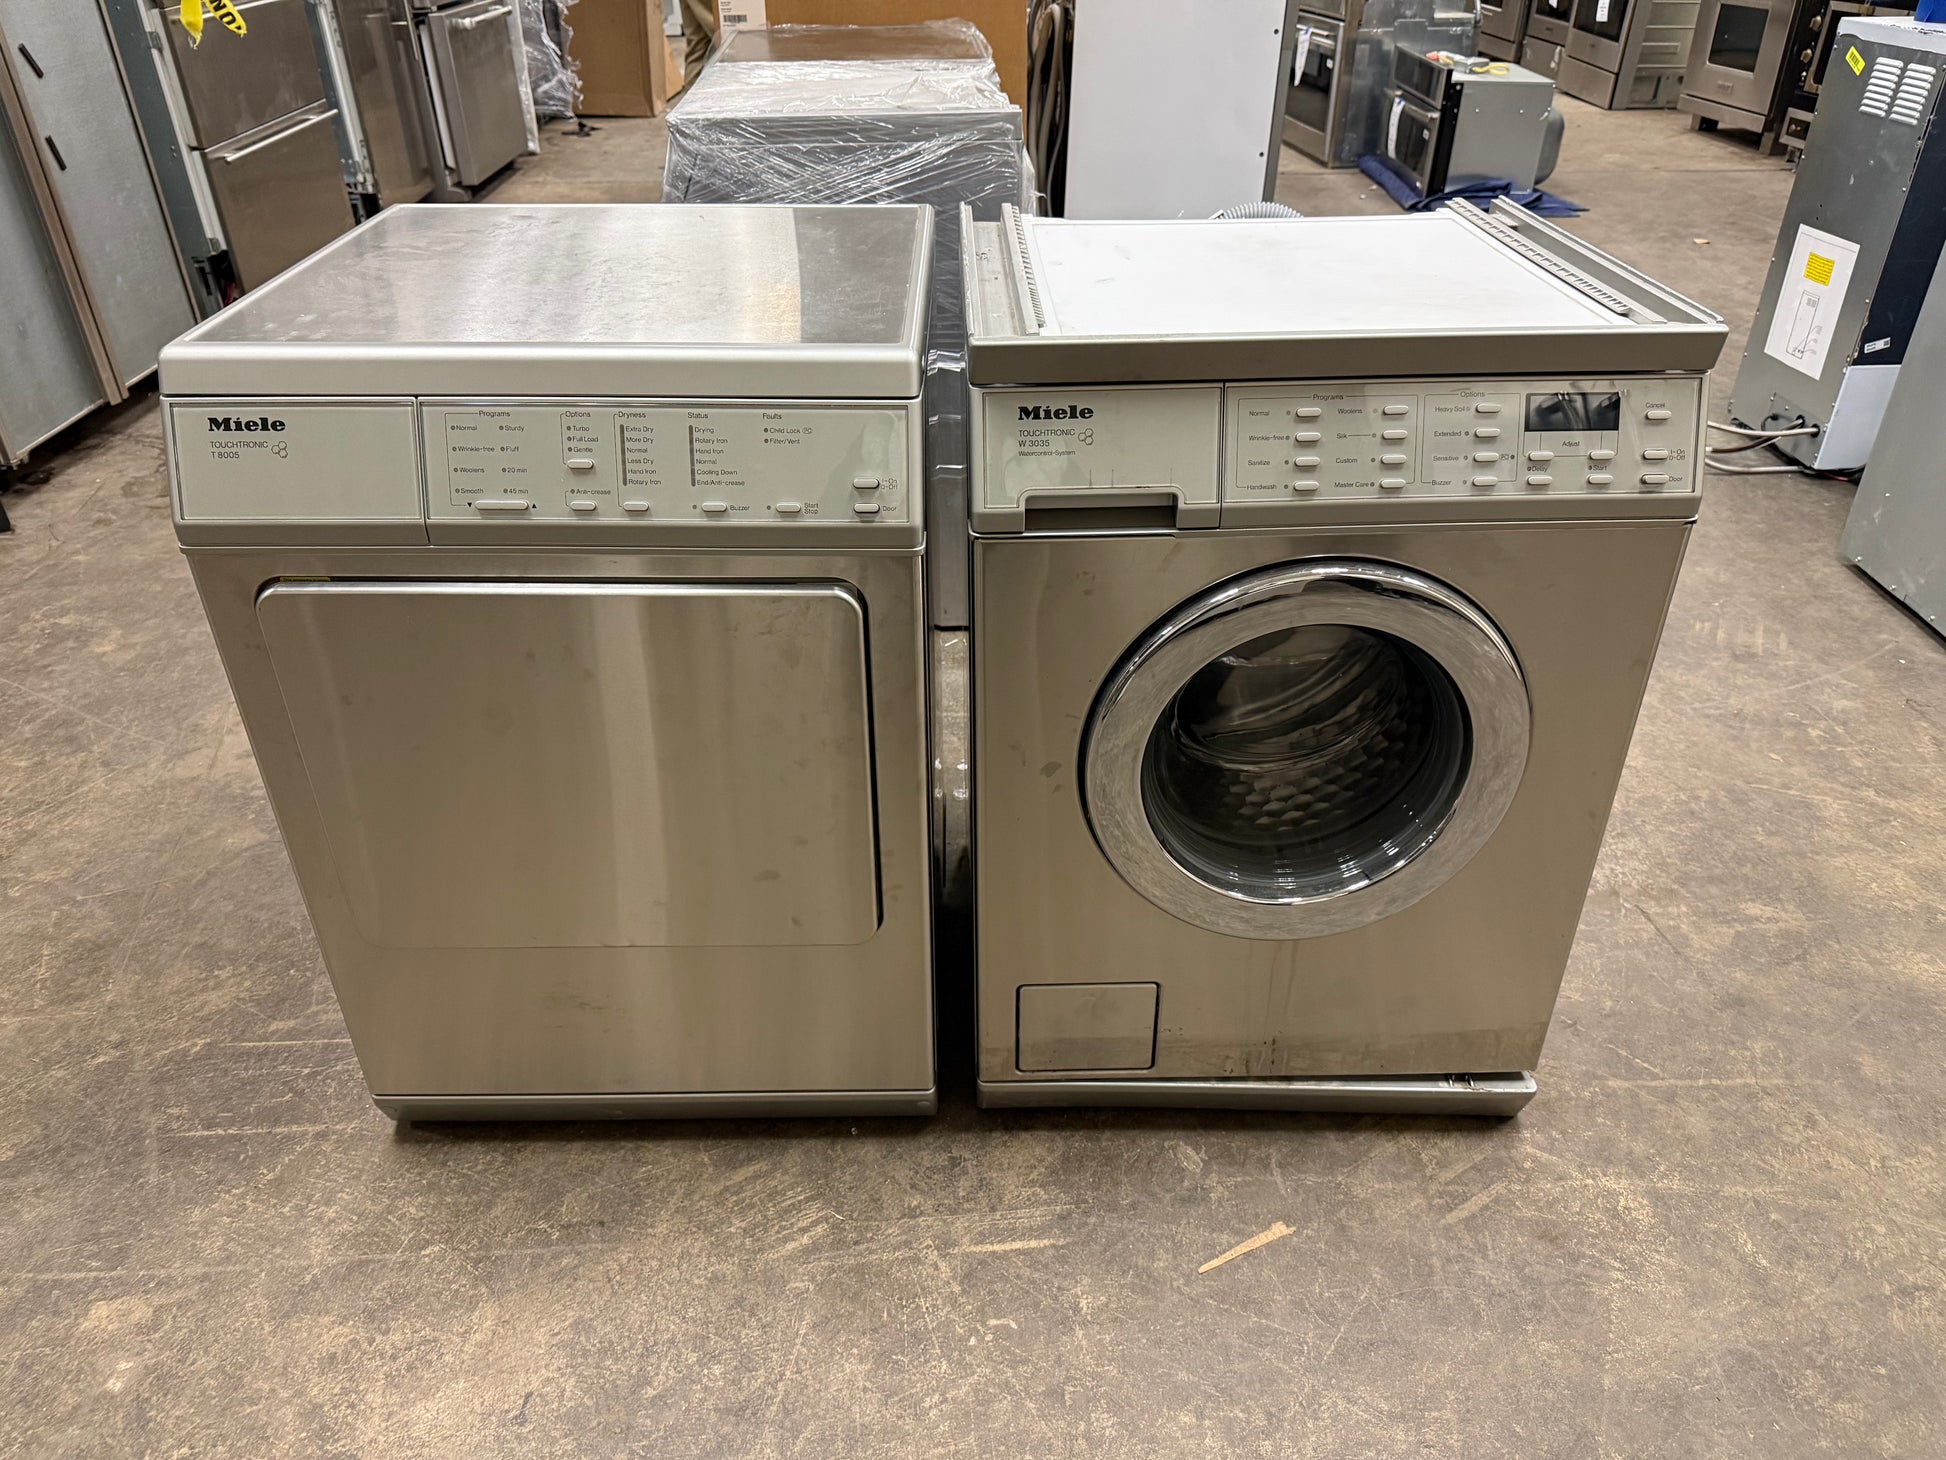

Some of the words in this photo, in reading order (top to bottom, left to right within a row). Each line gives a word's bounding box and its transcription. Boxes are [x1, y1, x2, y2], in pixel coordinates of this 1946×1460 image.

[1312, 393, 1344, 401] Programs
[1018, 405, 1094, 420] Miele
[1434, 405, 1454, 413] Heavy
[478, 410, 511, 418] Programs
[618, 411, 646, 419] Dryness
[207, 417, 286, 432] Miele
[643, 426, 654, 434] Dry
[1018, 429, 1076, 437] TOUCHTRONIC
[210, 441, 268, 449] TOUCHTRONIC
[769, 437, 800, 445] Filter/Vent
